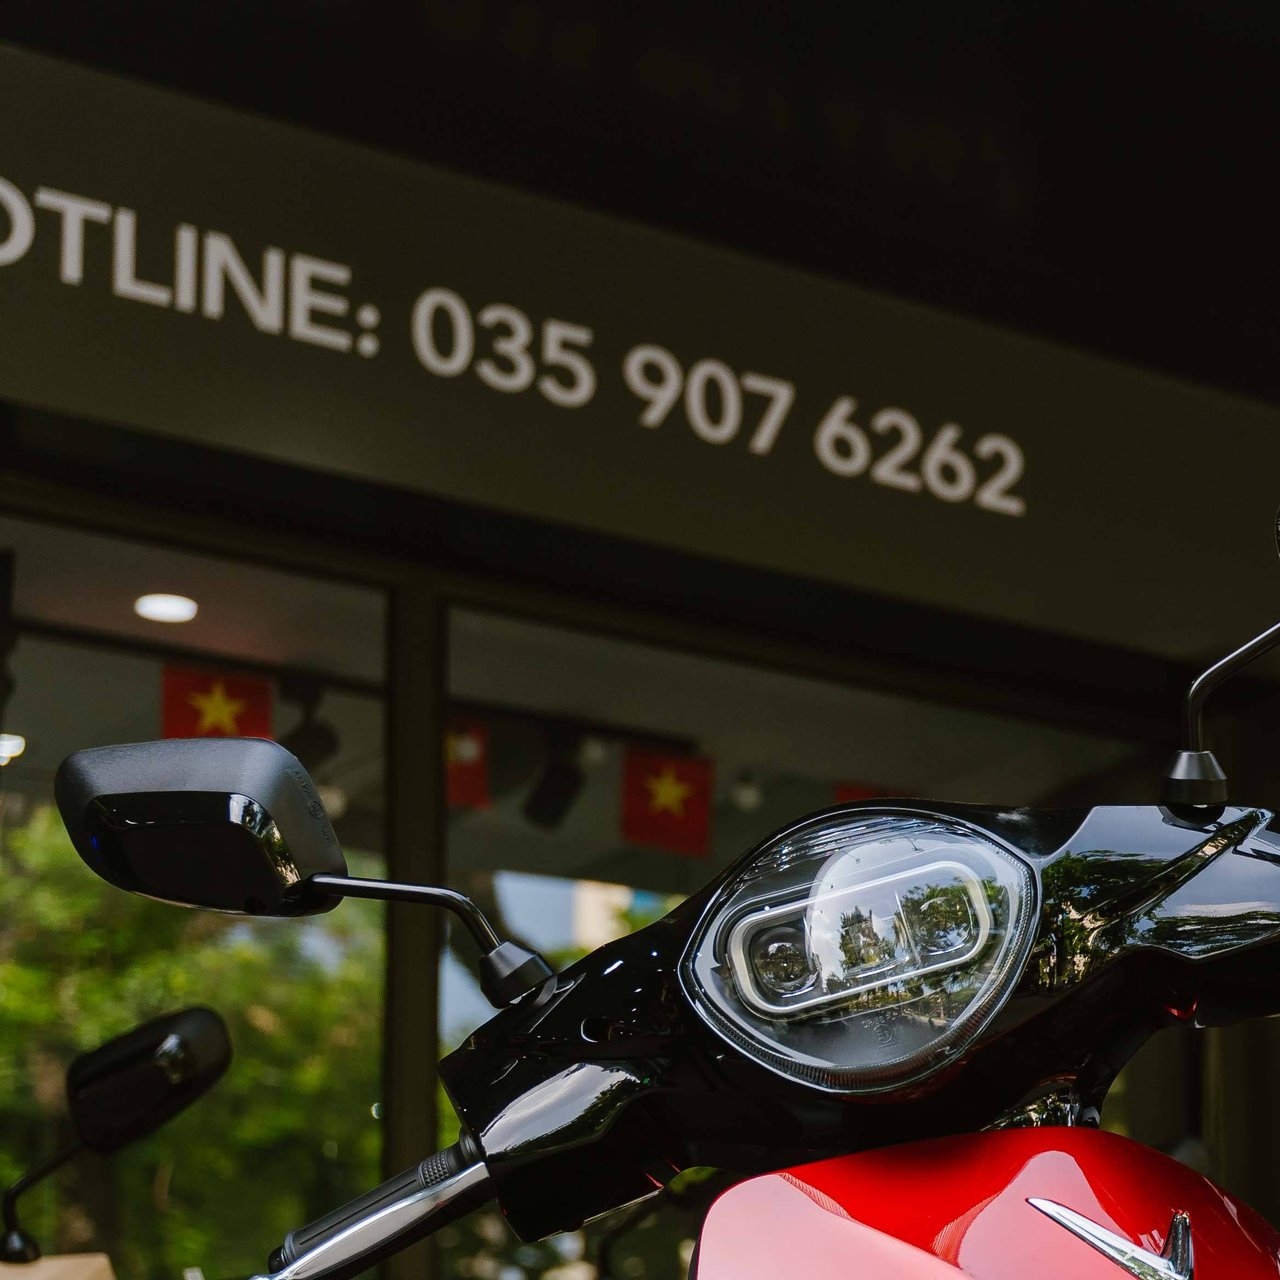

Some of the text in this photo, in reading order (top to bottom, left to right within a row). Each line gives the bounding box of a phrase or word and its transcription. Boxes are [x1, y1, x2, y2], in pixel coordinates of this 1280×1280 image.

[411, 286, 597, 408] 035
[622, 343, 795, 456] 907
[813, 395, 1027, 516] 6262
